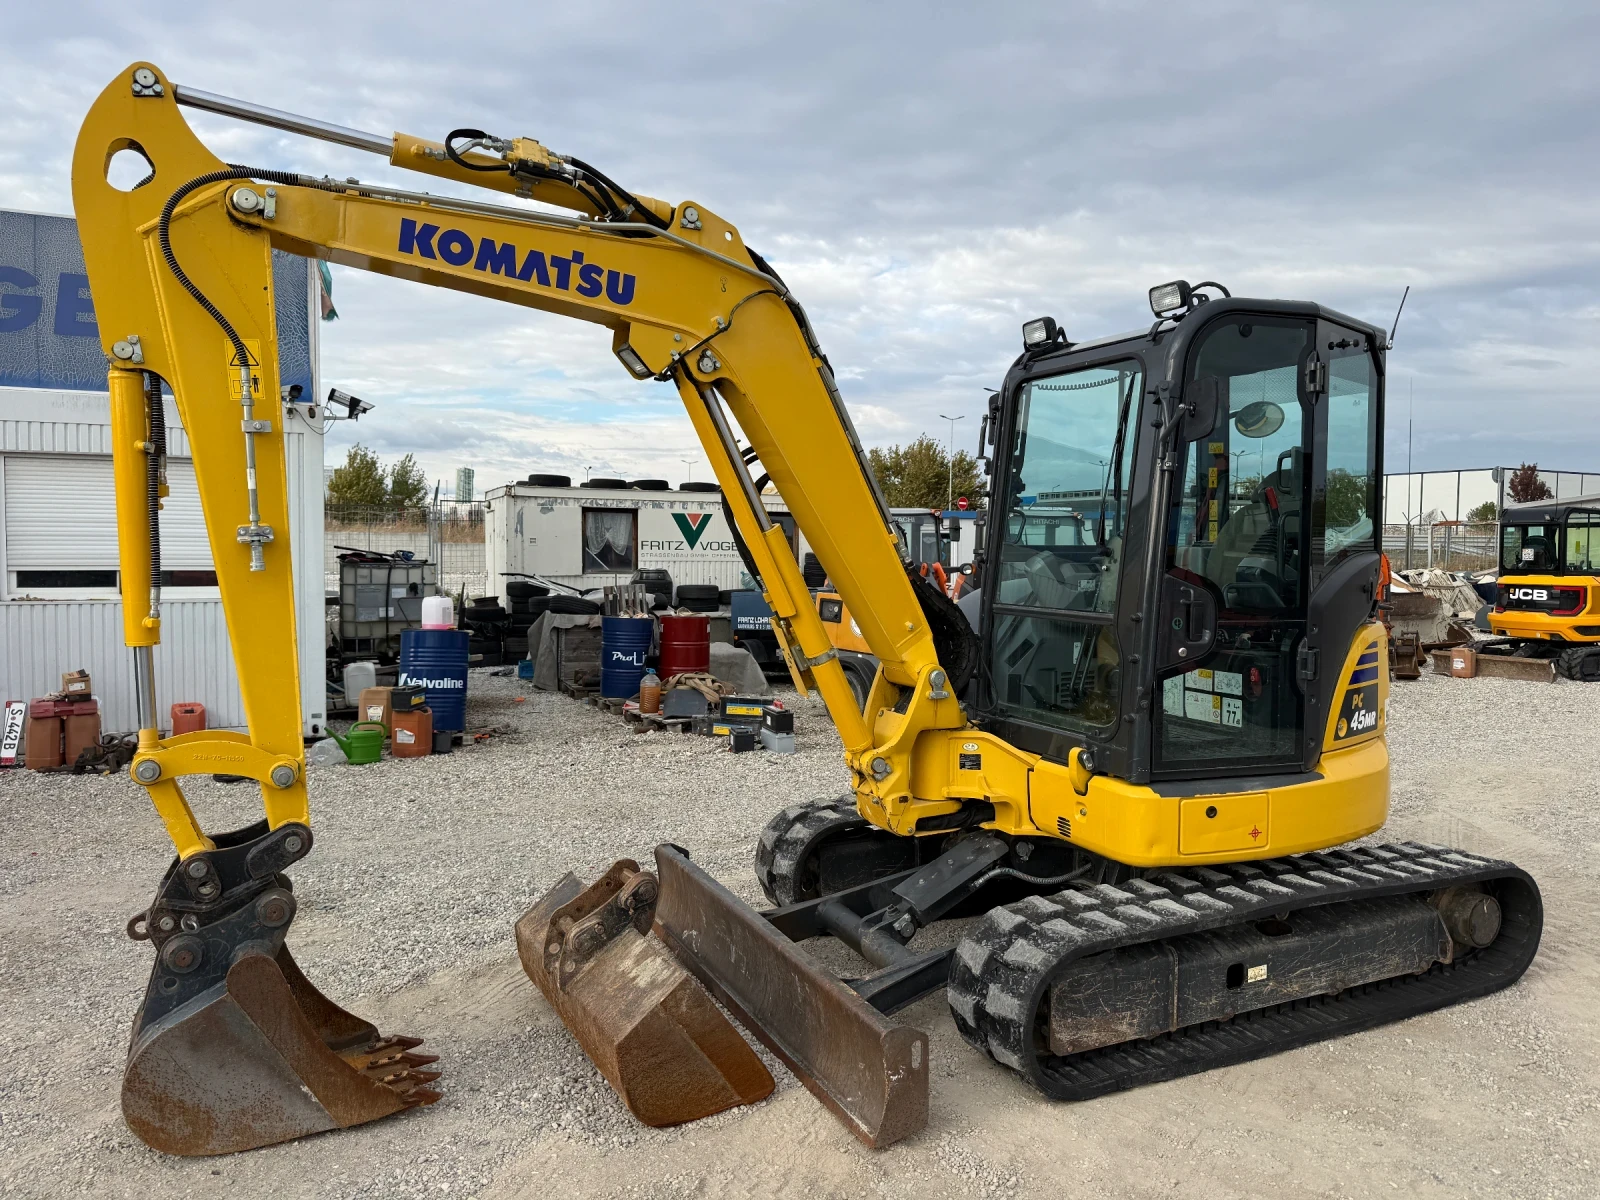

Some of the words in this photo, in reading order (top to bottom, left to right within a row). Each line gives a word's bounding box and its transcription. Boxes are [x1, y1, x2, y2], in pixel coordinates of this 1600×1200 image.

[398, 217, 636, 305] KOMATSU
[640, 540, 684, 551] FRITZ
[1510, 588, 1548, 600] JCB
[406, 677, 464, 689] Valvoline
[1352, 693, 1364, 710] PC
[10, 708, 23, 716] S
[1226, 709, 1236, 724] 77
[1350, 709, 1376, 731] 45MR
